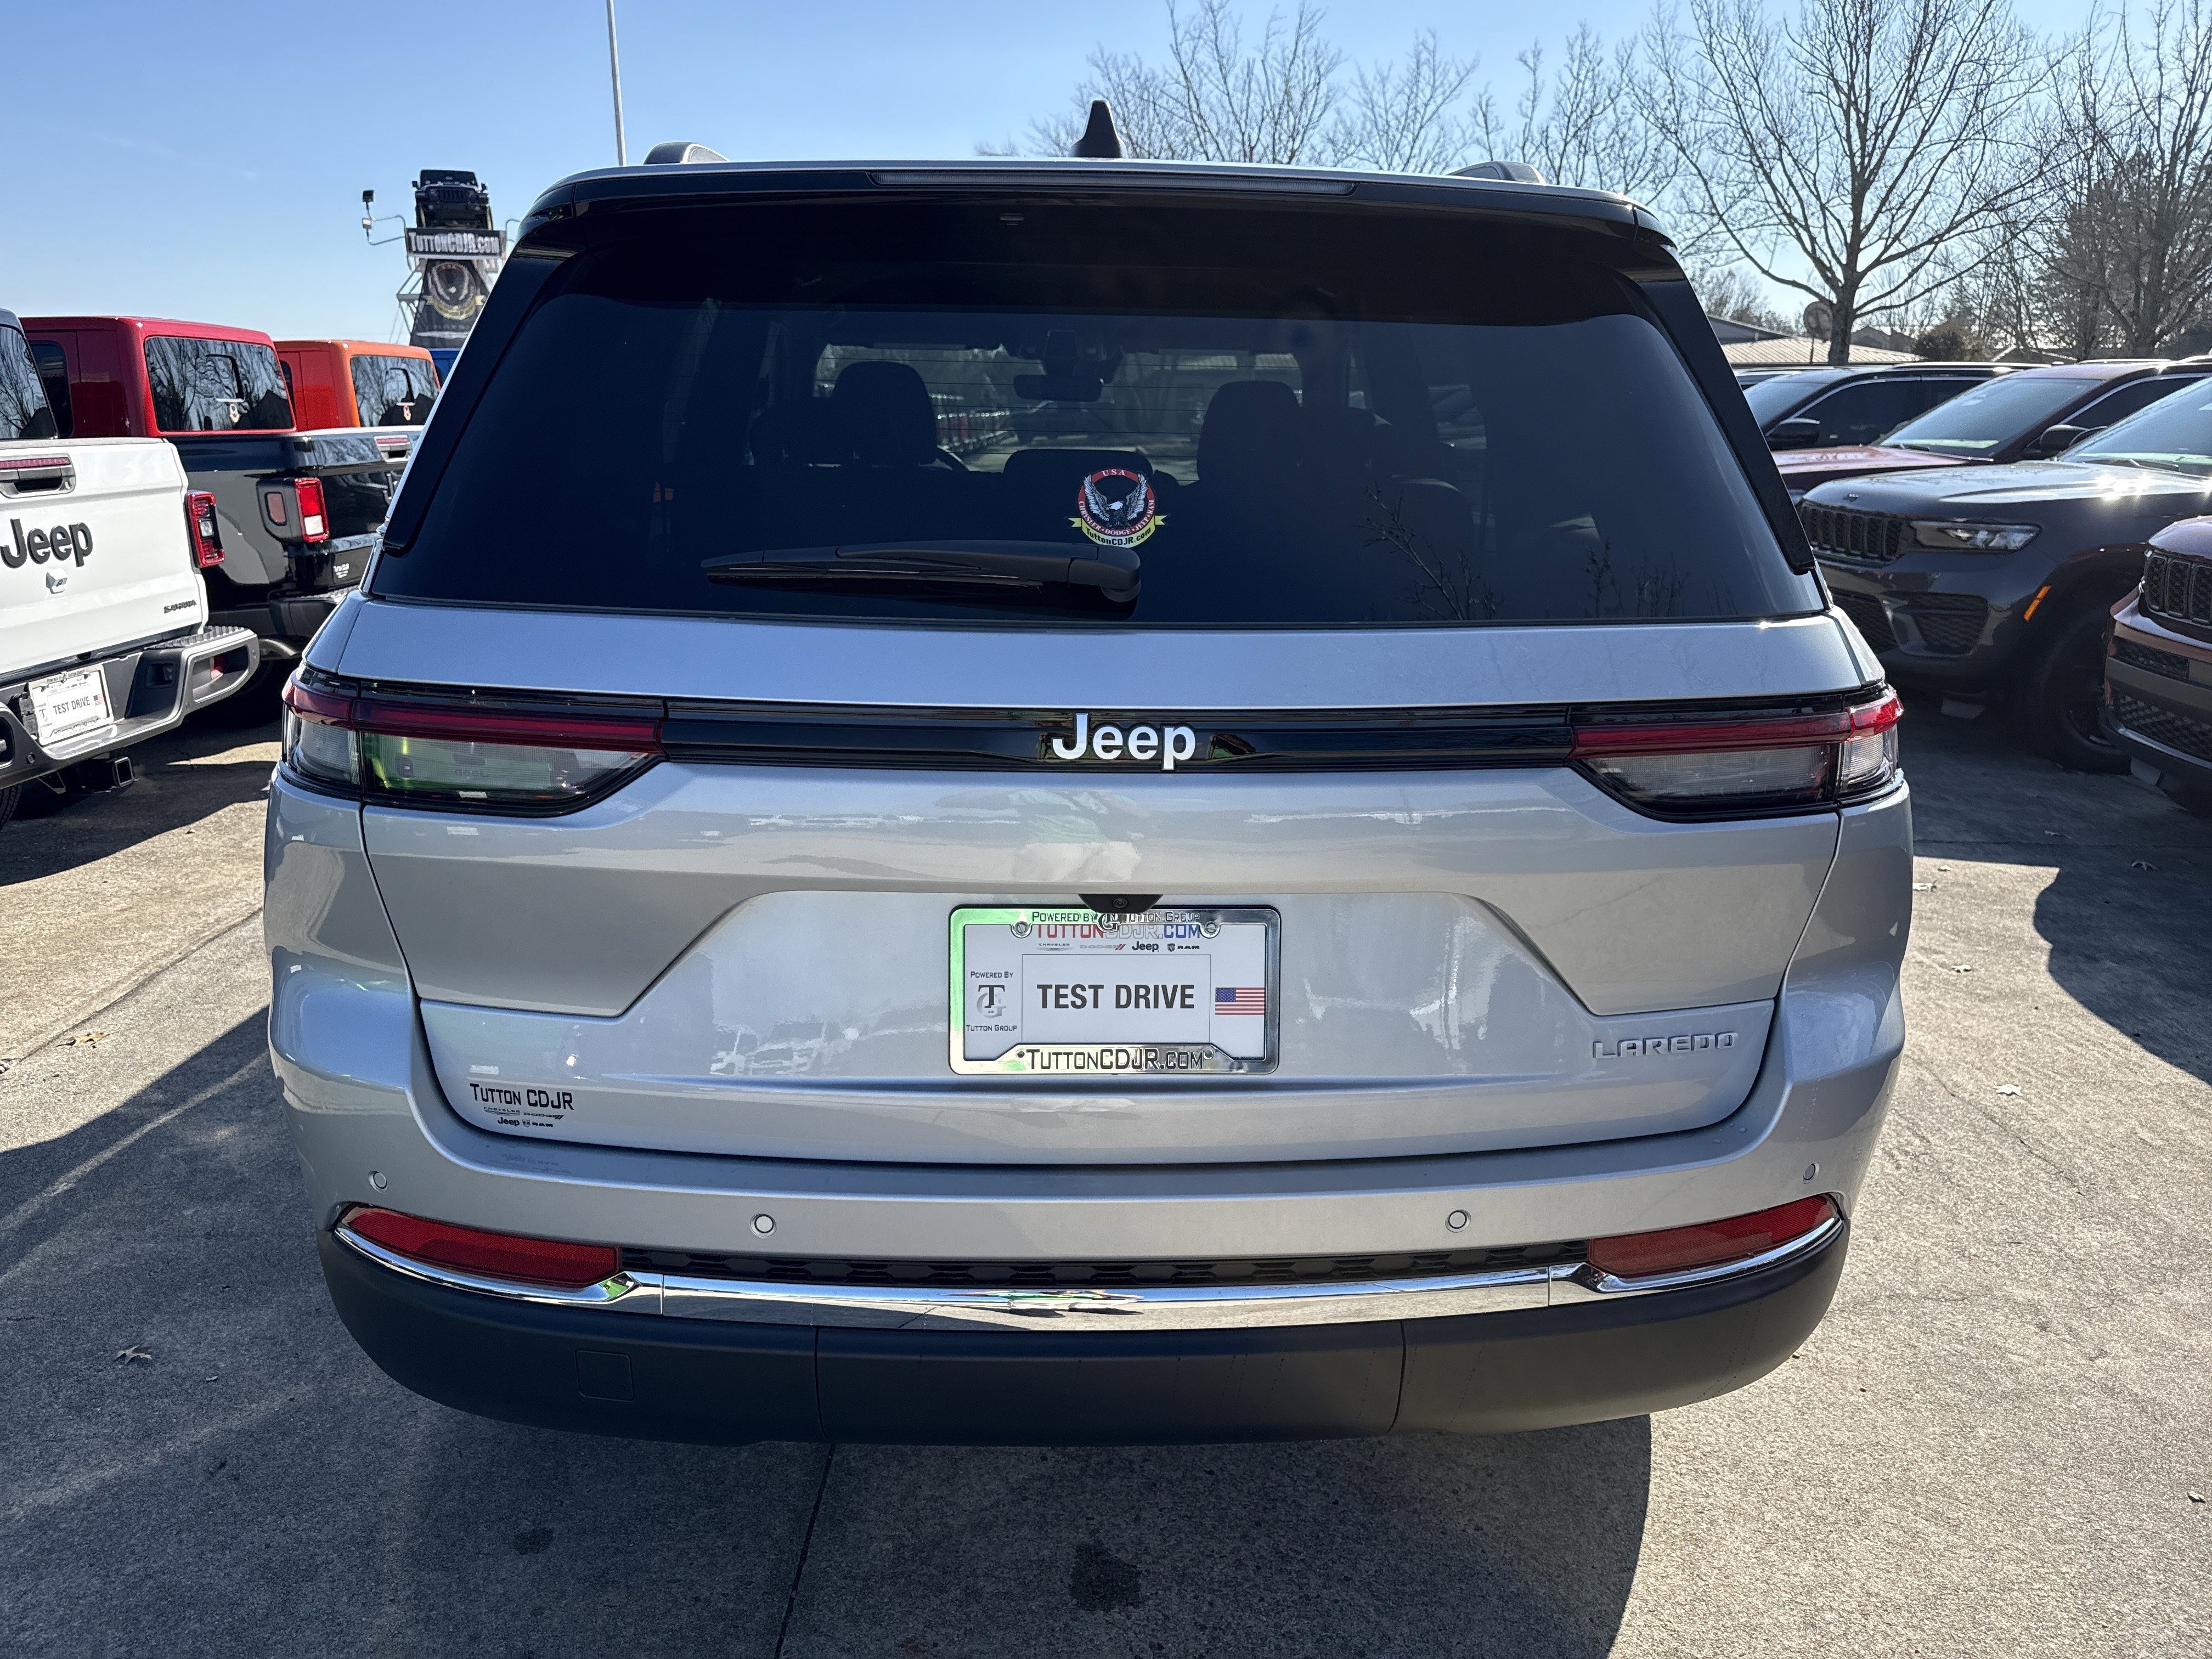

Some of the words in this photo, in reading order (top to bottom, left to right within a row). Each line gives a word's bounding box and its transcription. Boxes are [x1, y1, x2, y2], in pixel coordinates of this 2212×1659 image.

[1079, 501, 1102, 531] CHRYSLER
[1135, 515, 1150, 531] JEEP
[0, 518, 93, 568] Jeep
[1086, 526, 1152, 545] TuttonCDJR.com
[53, 702, 70, 715] TEST
[71, 696, 91, 710] DRIVE
[1052, 713, 1196, 770] Jeep
[1131, 941, 1159, 952] Jeep
[1037, 984, 1104, 1009] TEST
[1115, 984, 1195, 1009] DRIVE
[1593, 1032, 1739, 1059] LAREDO
[527, 1089, 574, 1110] CDJR
[497, 1117, 520, 1127] Jeep
